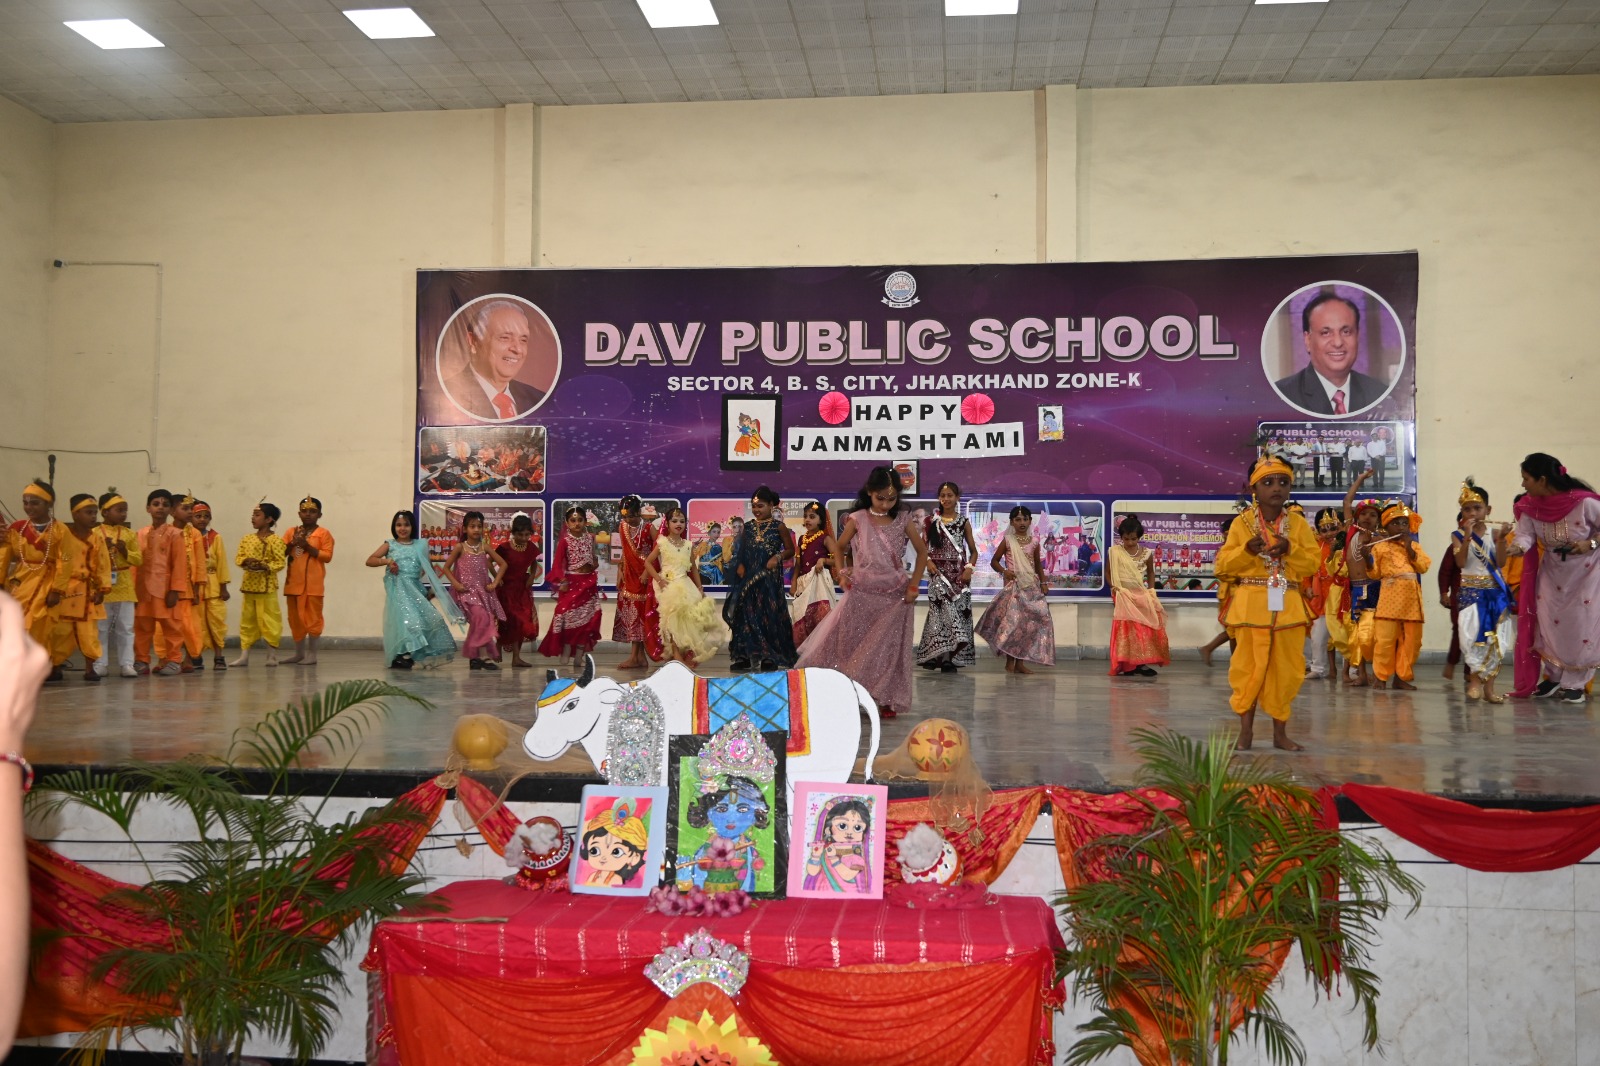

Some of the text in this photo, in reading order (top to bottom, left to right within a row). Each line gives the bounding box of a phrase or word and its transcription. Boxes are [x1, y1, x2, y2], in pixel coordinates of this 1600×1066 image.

[584, 315, 1239, 367] DAV PUBLIC SCHOOL
[667, 372, 1142, 394] SECTOR 4, B. S. CITY, JHARKHAND ZONE-K
[855, 404, 957, 421] HAPPY
[790, 430, 1020, 452] JANMASHTAMI
[1275, 429, 1318, 437] PUBLIC
[1320, 429, 1367, 437] SCHOOL
[1155, 520, 1192, 528] PUBLIC
[1193, 520, 1225, 529] SCHO
[1139, 532, 1188, 542] ELICITATION
